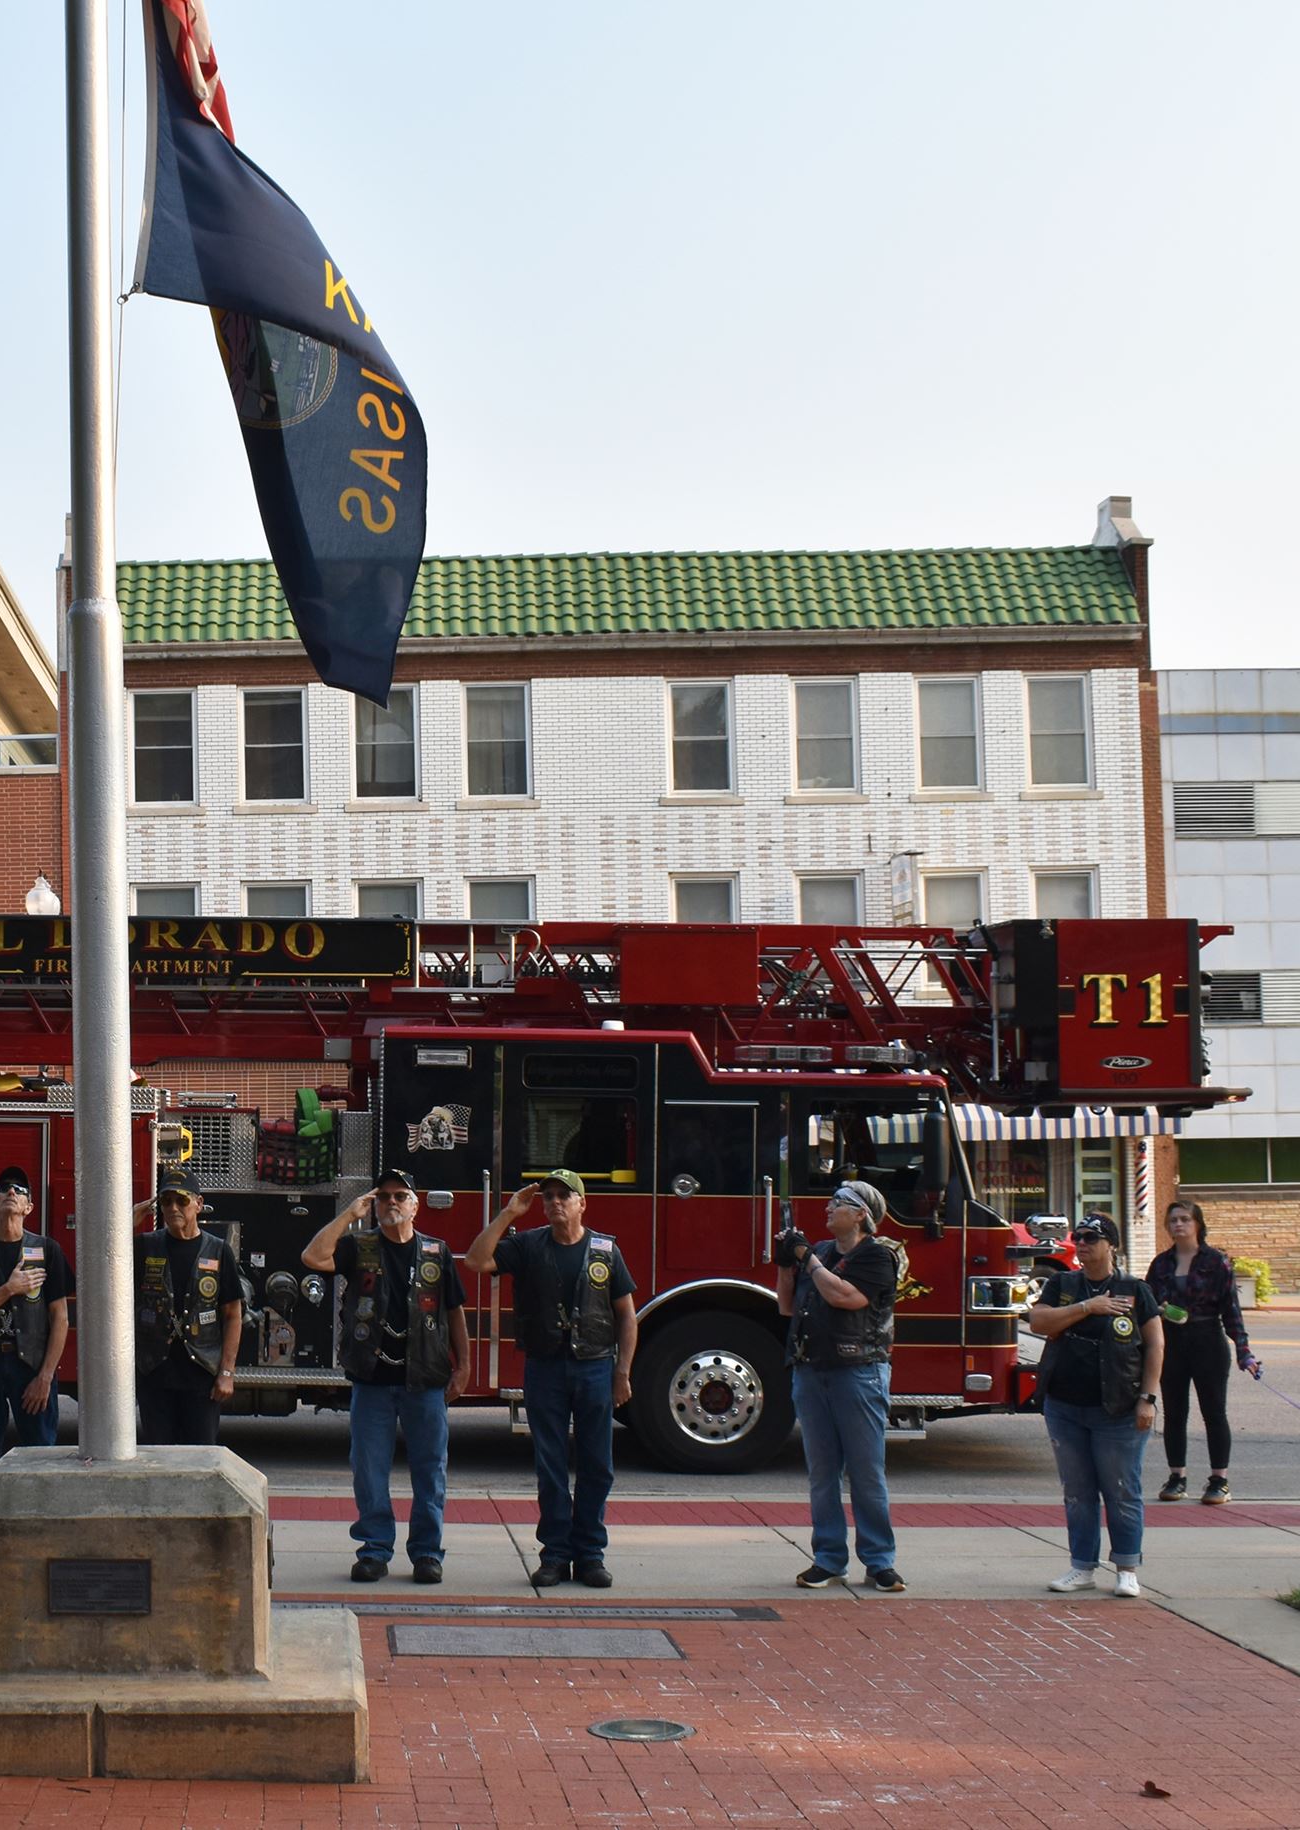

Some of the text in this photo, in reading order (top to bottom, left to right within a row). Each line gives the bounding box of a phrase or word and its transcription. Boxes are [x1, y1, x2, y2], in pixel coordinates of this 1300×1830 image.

[47, 919, 325, 960] DRADO
[33, 959, 234, 974] FIR ARTMENT
[1109, 1056, 1140, 1067] Pierce
[1021, 1186, 1046, 1194] SALON
